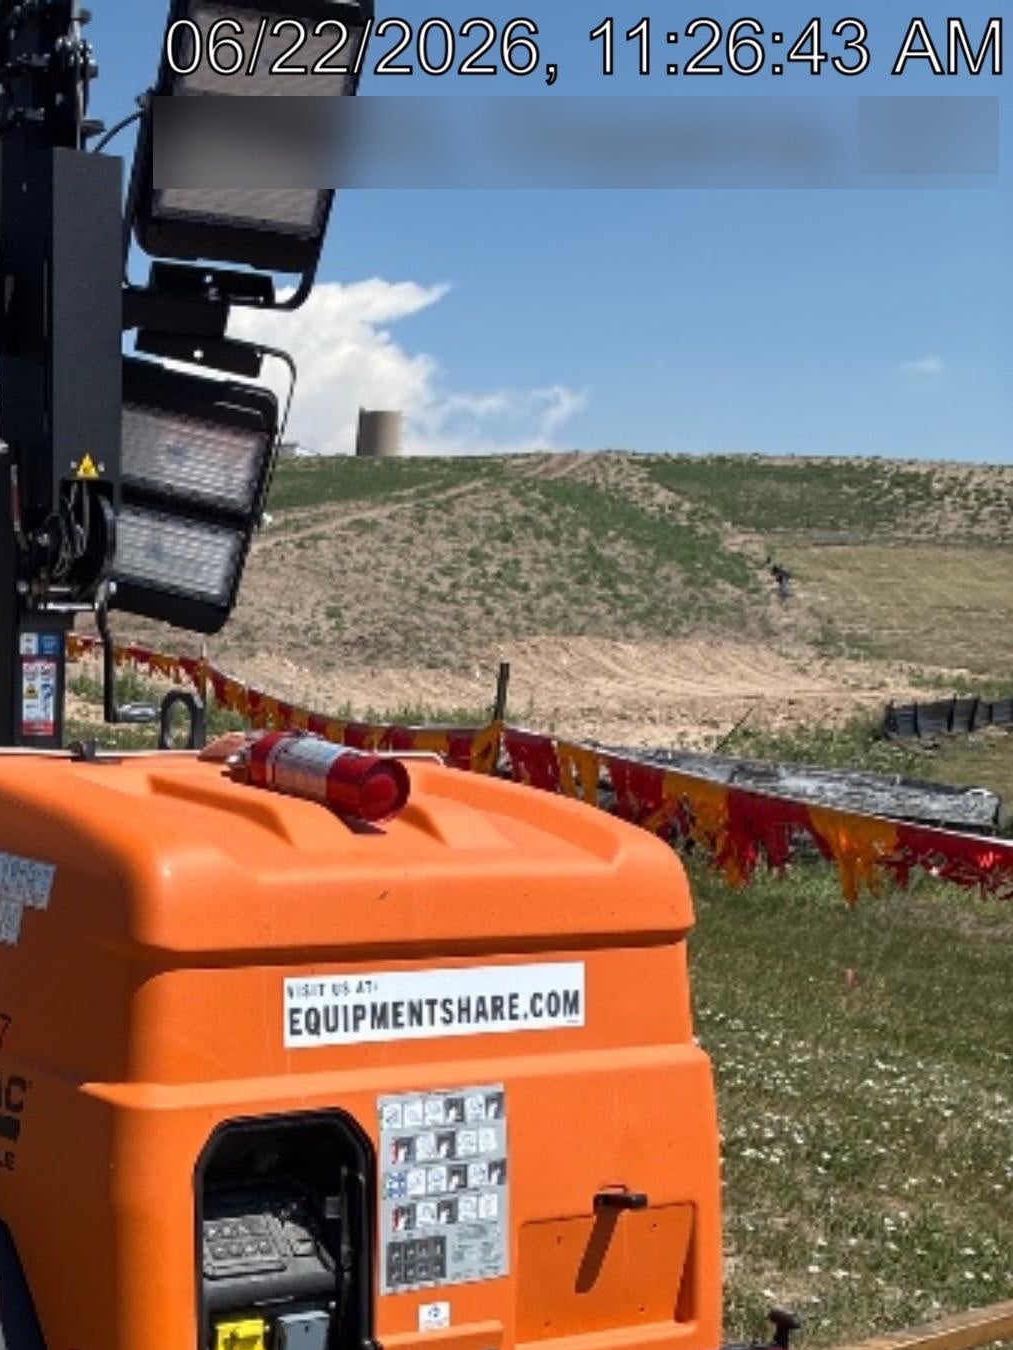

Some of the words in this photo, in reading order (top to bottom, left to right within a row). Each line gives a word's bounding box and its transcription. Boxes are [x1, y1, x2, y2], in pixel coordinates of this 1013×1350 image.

[287, 983, 325, 999] VISIT
[332, 981, 350, 997] US
[288, 988, 580, 1037] EQUIPMENTSHARE.COM
